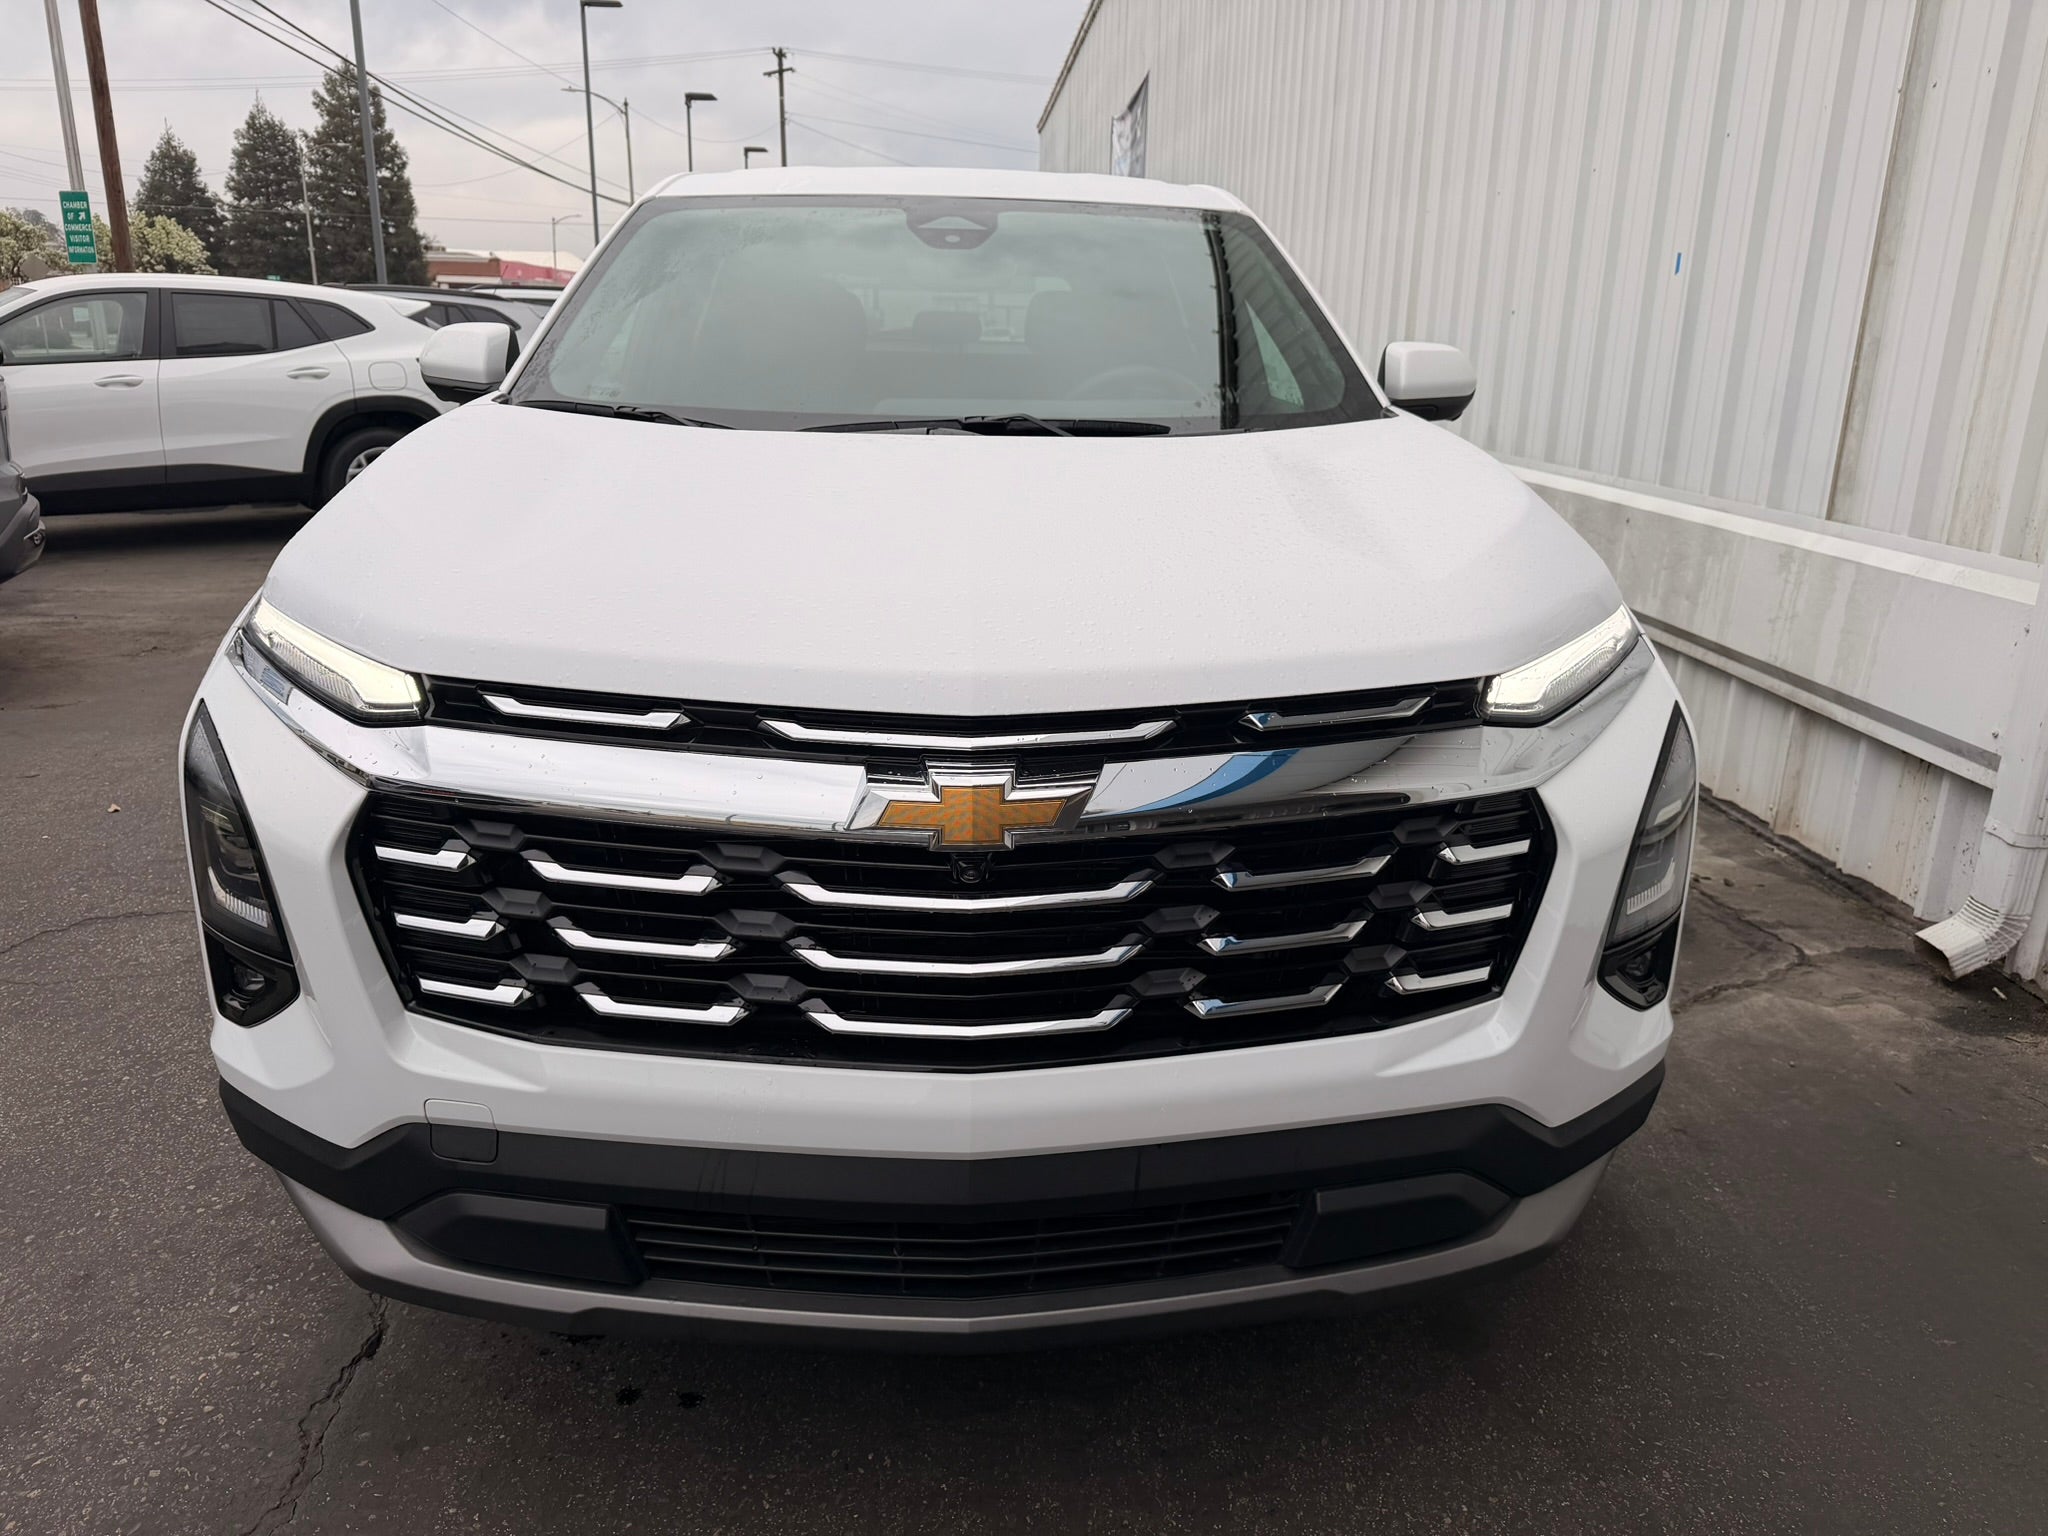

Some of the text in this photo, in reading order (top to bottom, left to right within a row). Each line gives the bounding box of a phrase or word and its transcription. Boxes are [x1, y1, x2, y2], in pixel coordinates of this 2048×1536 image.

[62, 201, 88, 209] CHAMBER
[67, 212, 74, 220] OF
[65, 223, 92, 231] COMMERCE
[69, 234, 90, 243] VISITOR
[68, 246, 95, 254] INFORMATION
